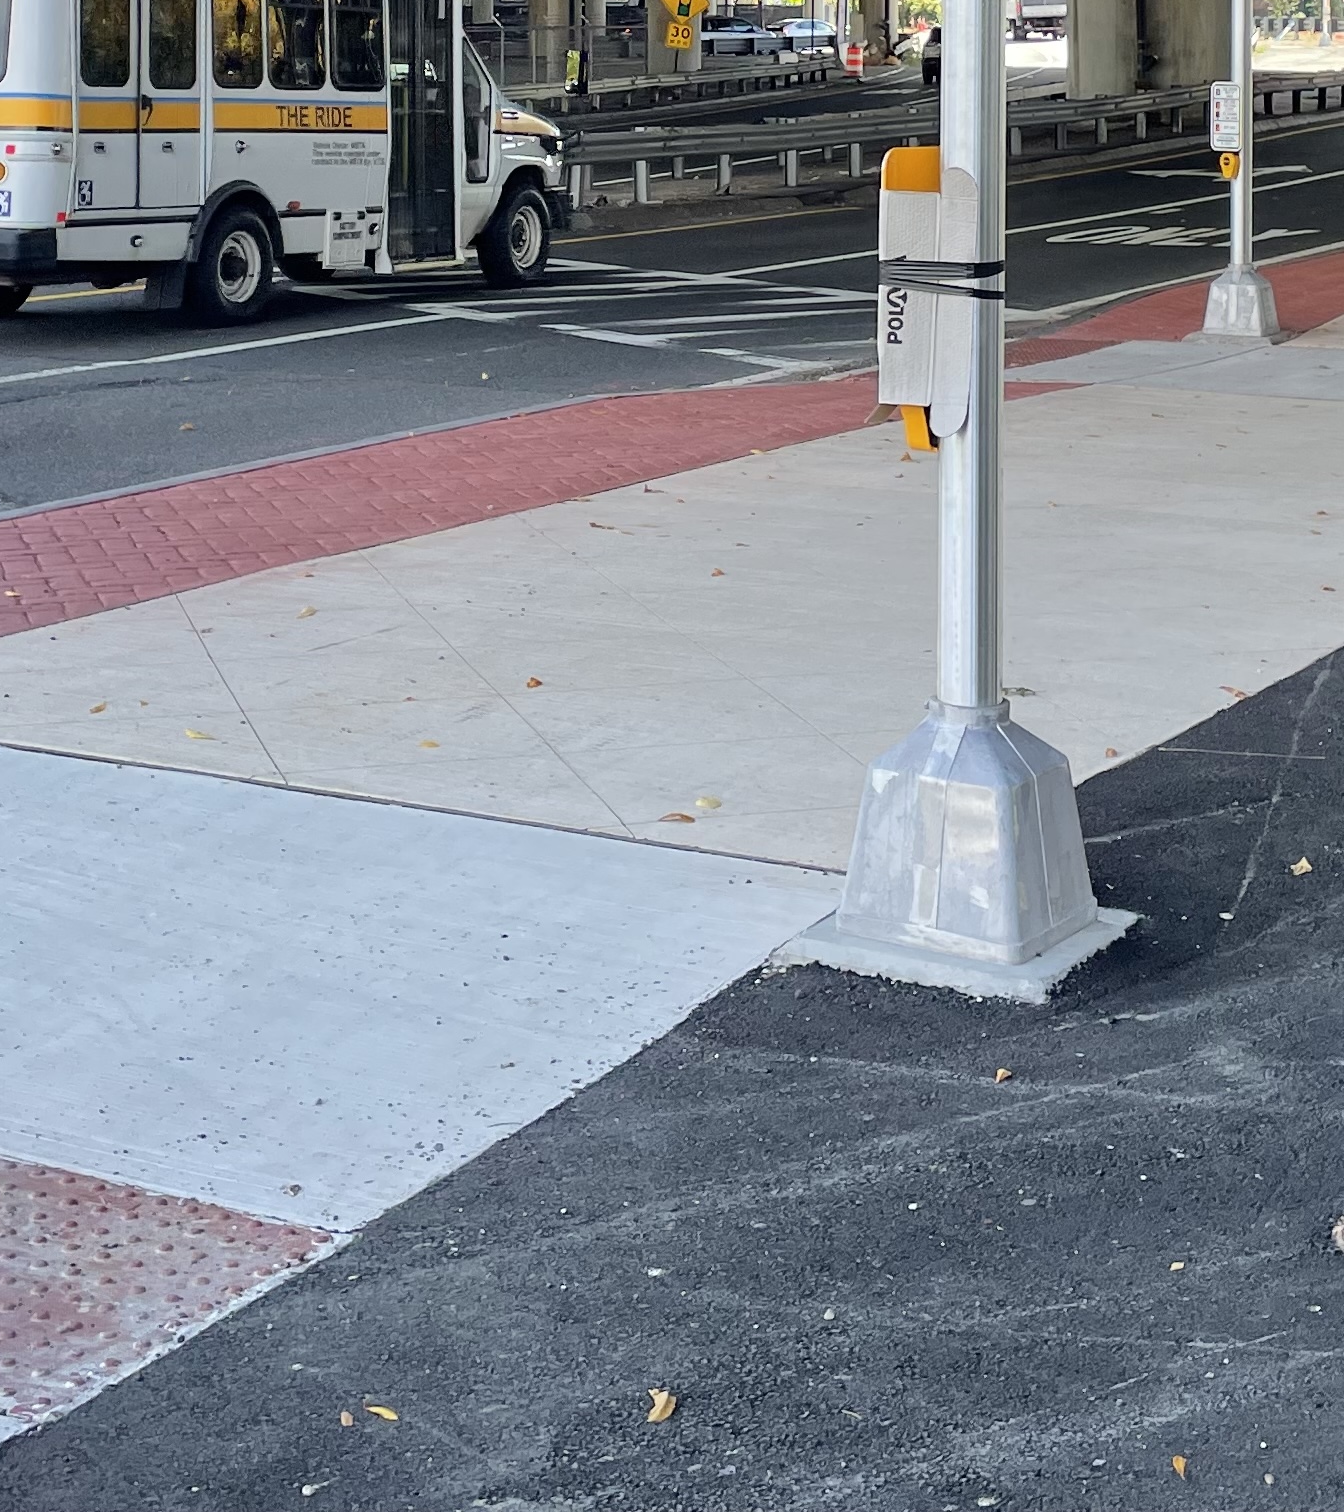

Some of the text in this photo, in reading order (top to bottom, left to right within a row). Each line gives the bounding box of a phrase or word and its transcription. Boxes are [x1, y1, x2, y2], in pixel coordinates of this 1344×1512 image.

[671, 25, 690, 39] 30
[276, 105, 353, 128] THE RIDE
